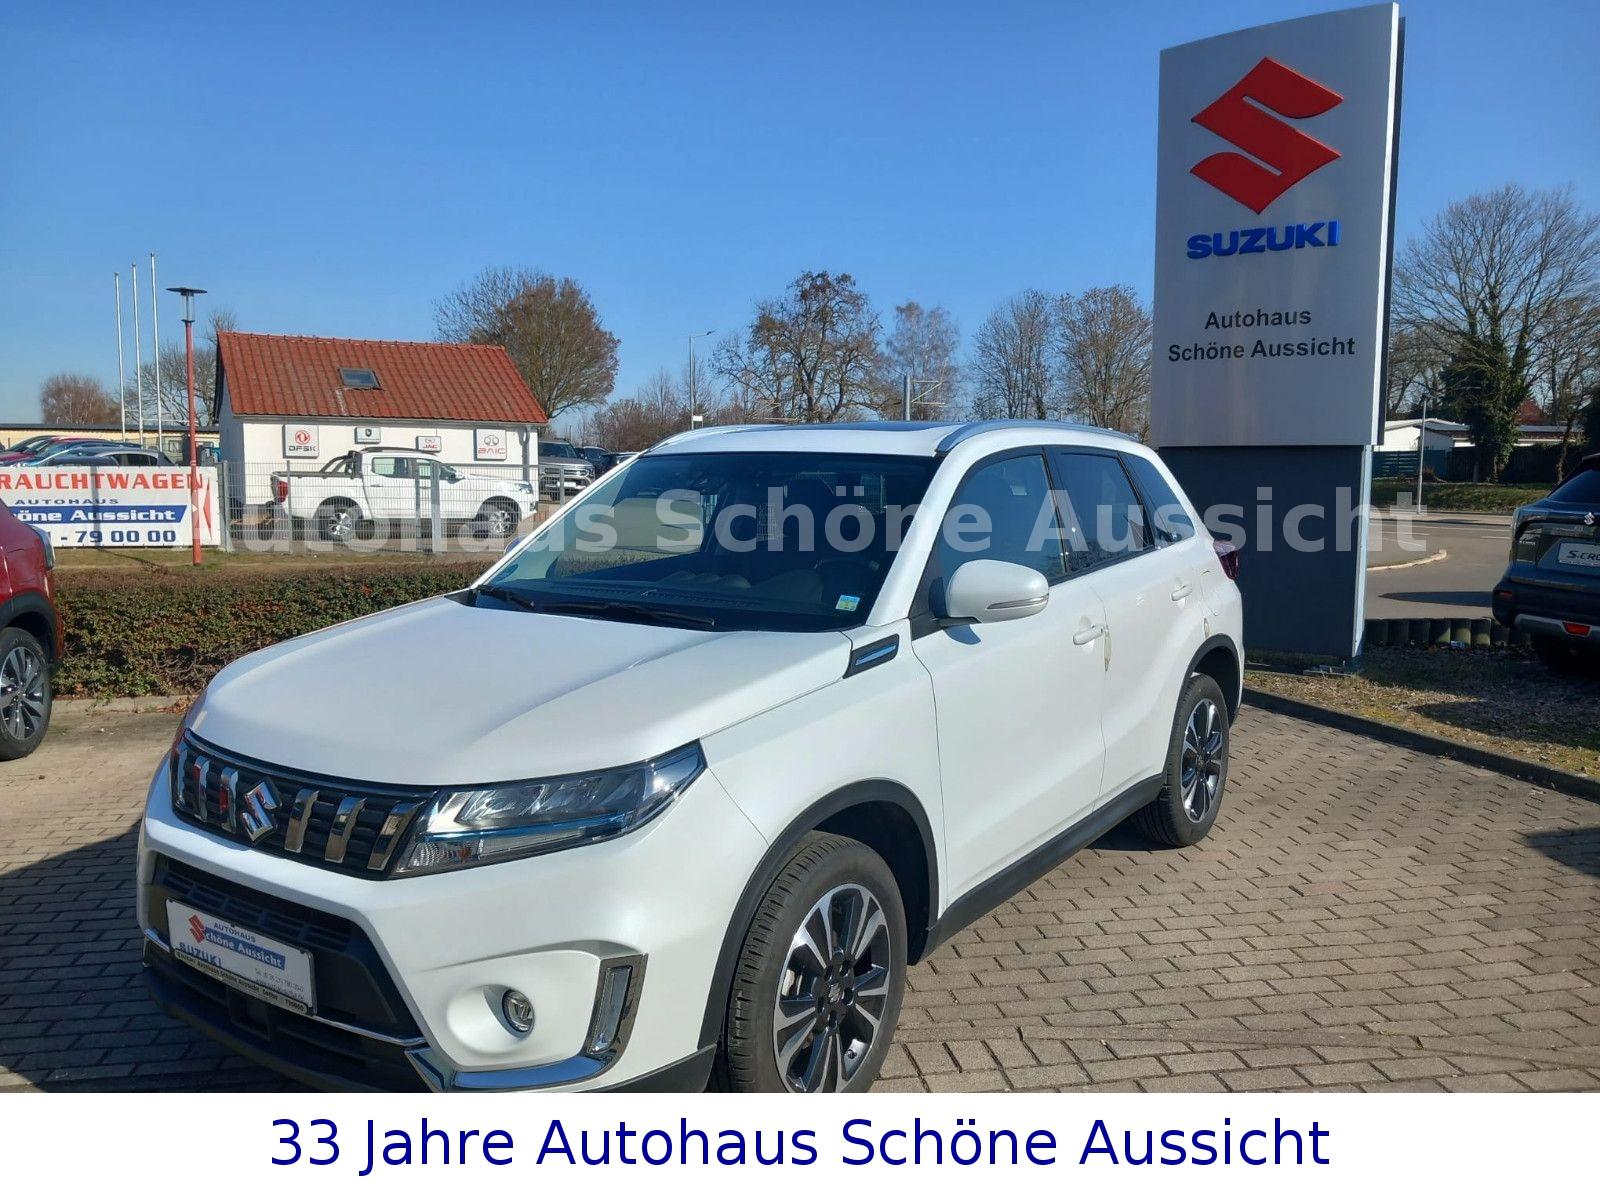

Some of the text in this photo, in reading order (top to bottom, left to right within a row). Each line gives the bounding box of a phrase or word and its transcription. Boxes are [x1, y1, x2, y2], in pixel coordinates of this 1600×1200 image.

[1186, 219, 1342, 259] SUZUKI
[1204, 308, 1312, 330] Autohaus
[1168, 336, 1356, 362] Schöne Aussicht
[14, 508, 176, 522] öne Aussicht
[75, 530, 103, 543] 79
[111, 530, 140, 543] 00
[147, 530, 176, 543] 00
[213, 922, 256, 943] AUTOHAUS
[237, 943, 283, 967] Aussicht
